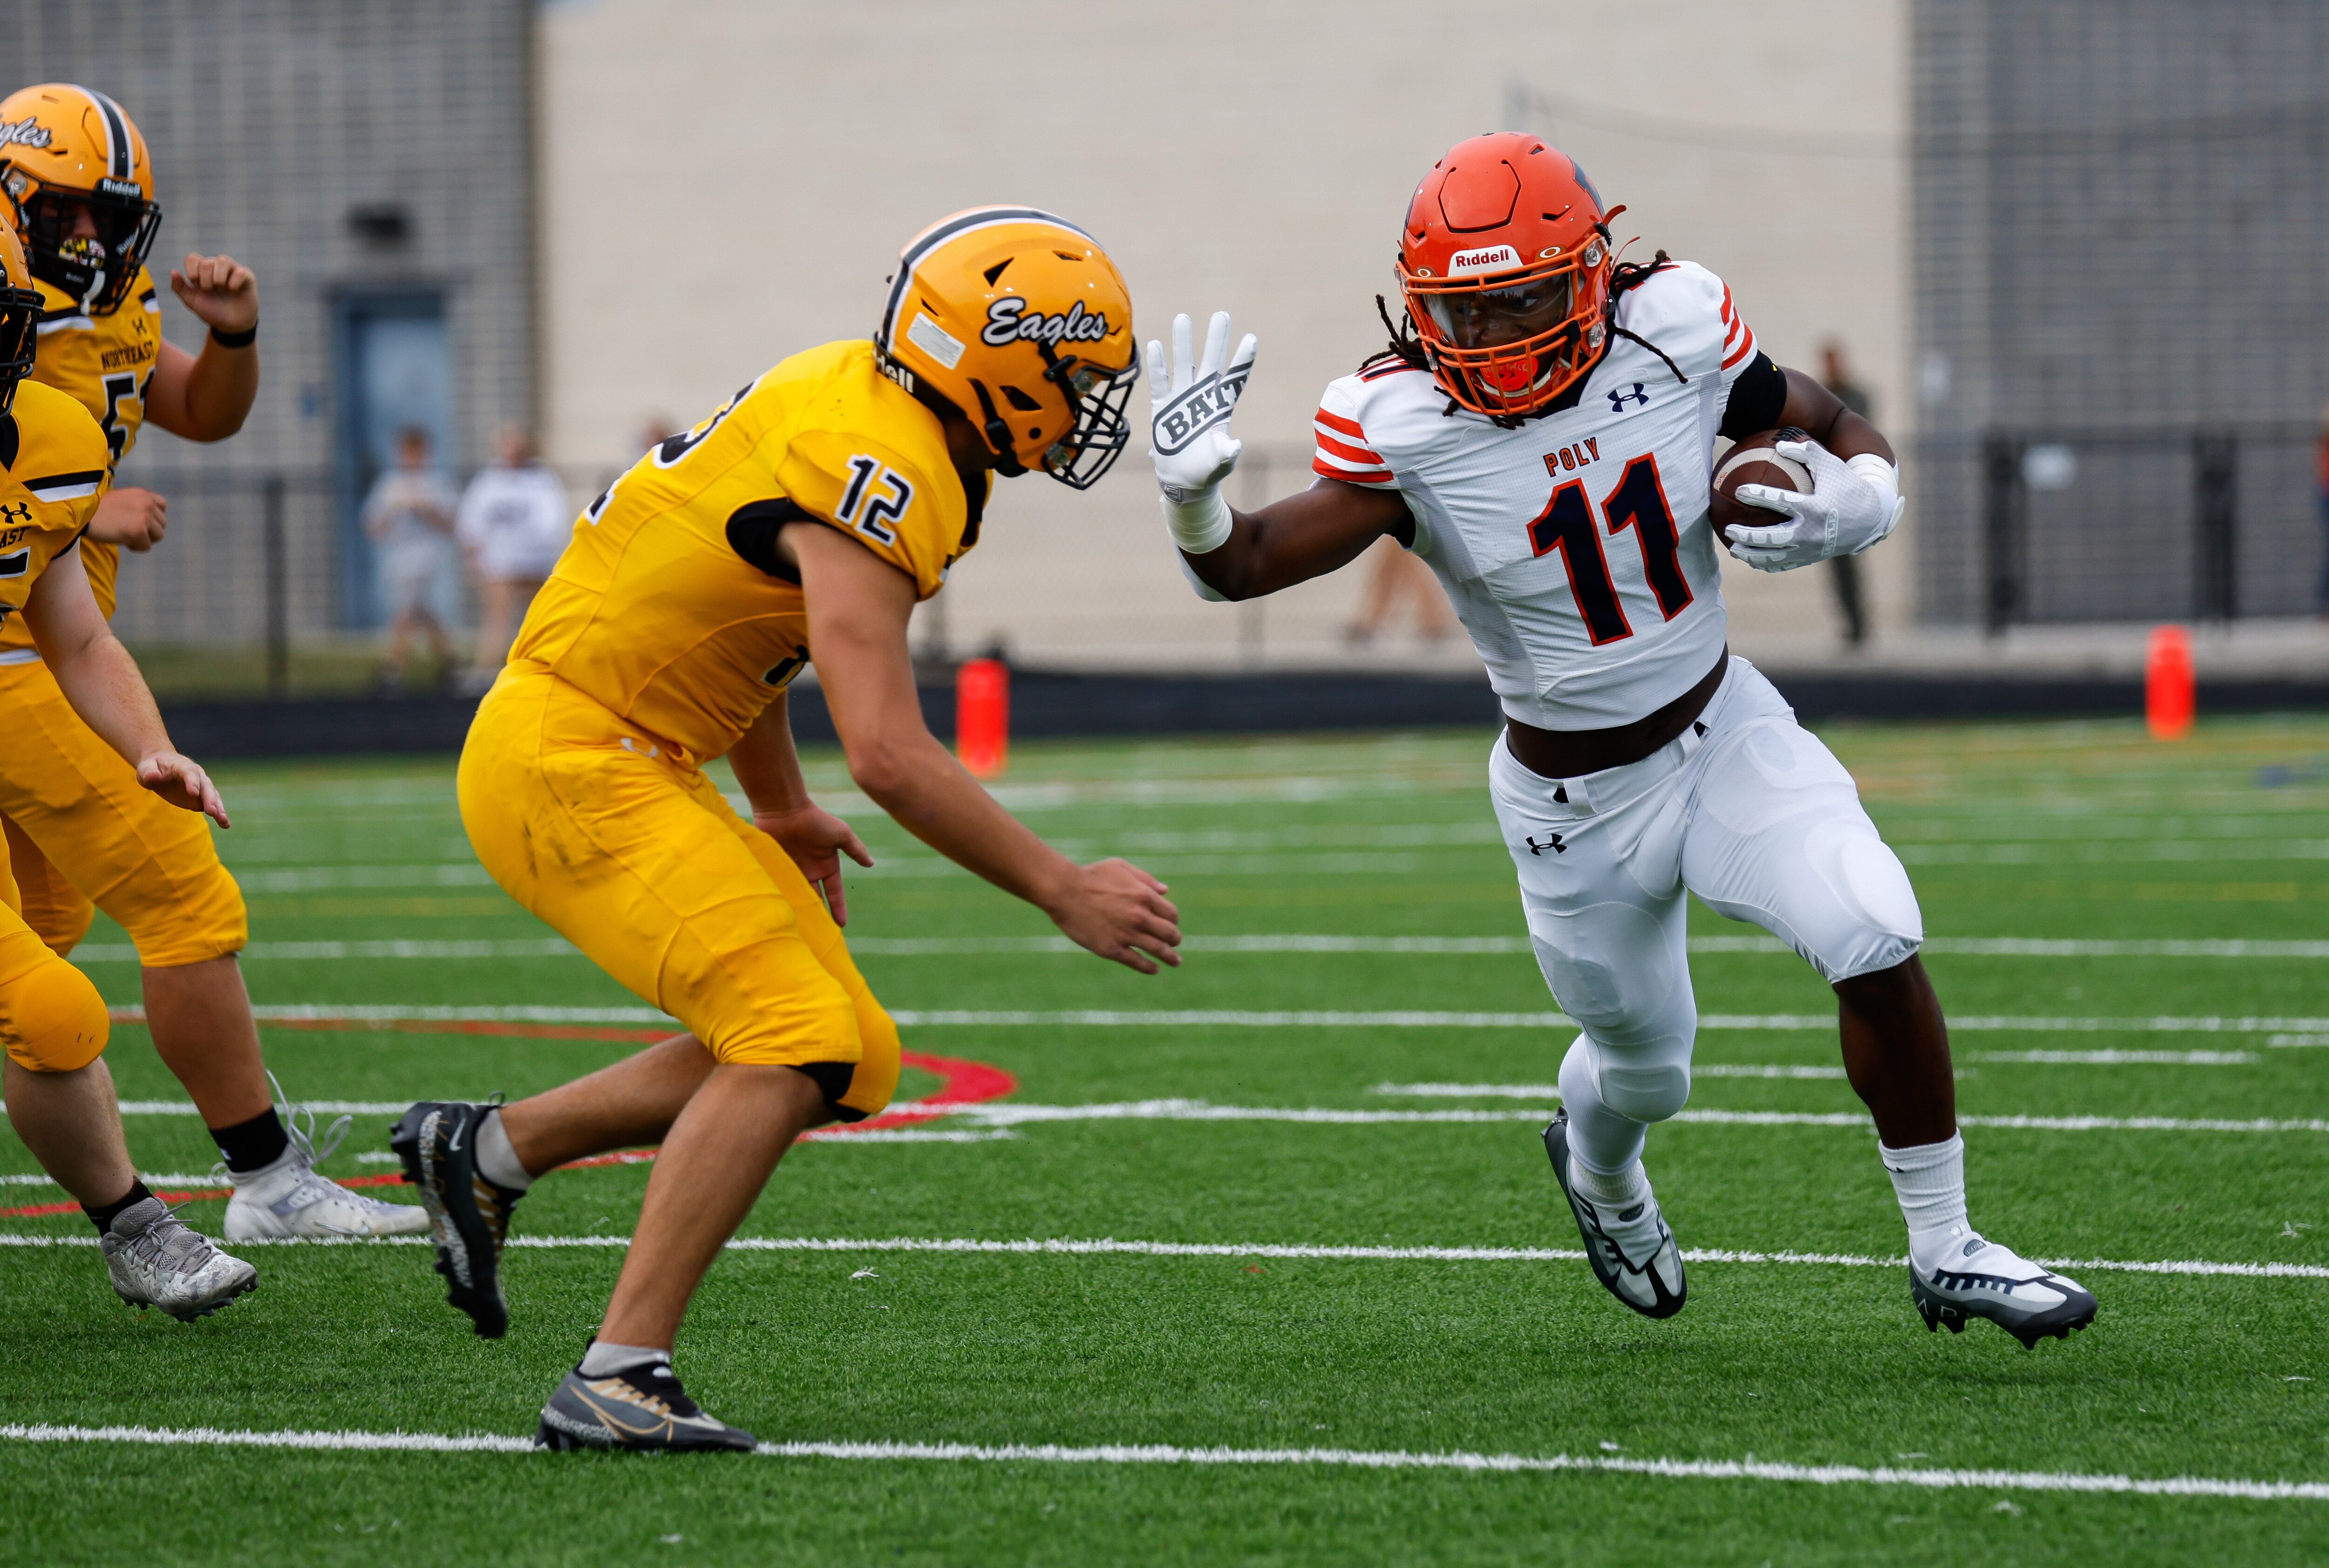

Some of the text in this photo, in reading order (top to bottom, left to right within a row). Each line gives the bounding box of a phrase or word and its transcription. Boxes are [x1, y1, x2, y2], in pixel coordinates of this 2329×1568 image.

[0, 116, 52, 149] gles
[1456, 249, 1509, 267] Riddell
[981, 296, 1109, 347] Eagles
[101, 341, 156, 371] NORTHEAST
[1161, 374, 1250, 445] BATT
[1543, 436, 1599, 477] POLY
[835, 454, 914, 547] 12
[1526, 452, 1694, 647] 11
